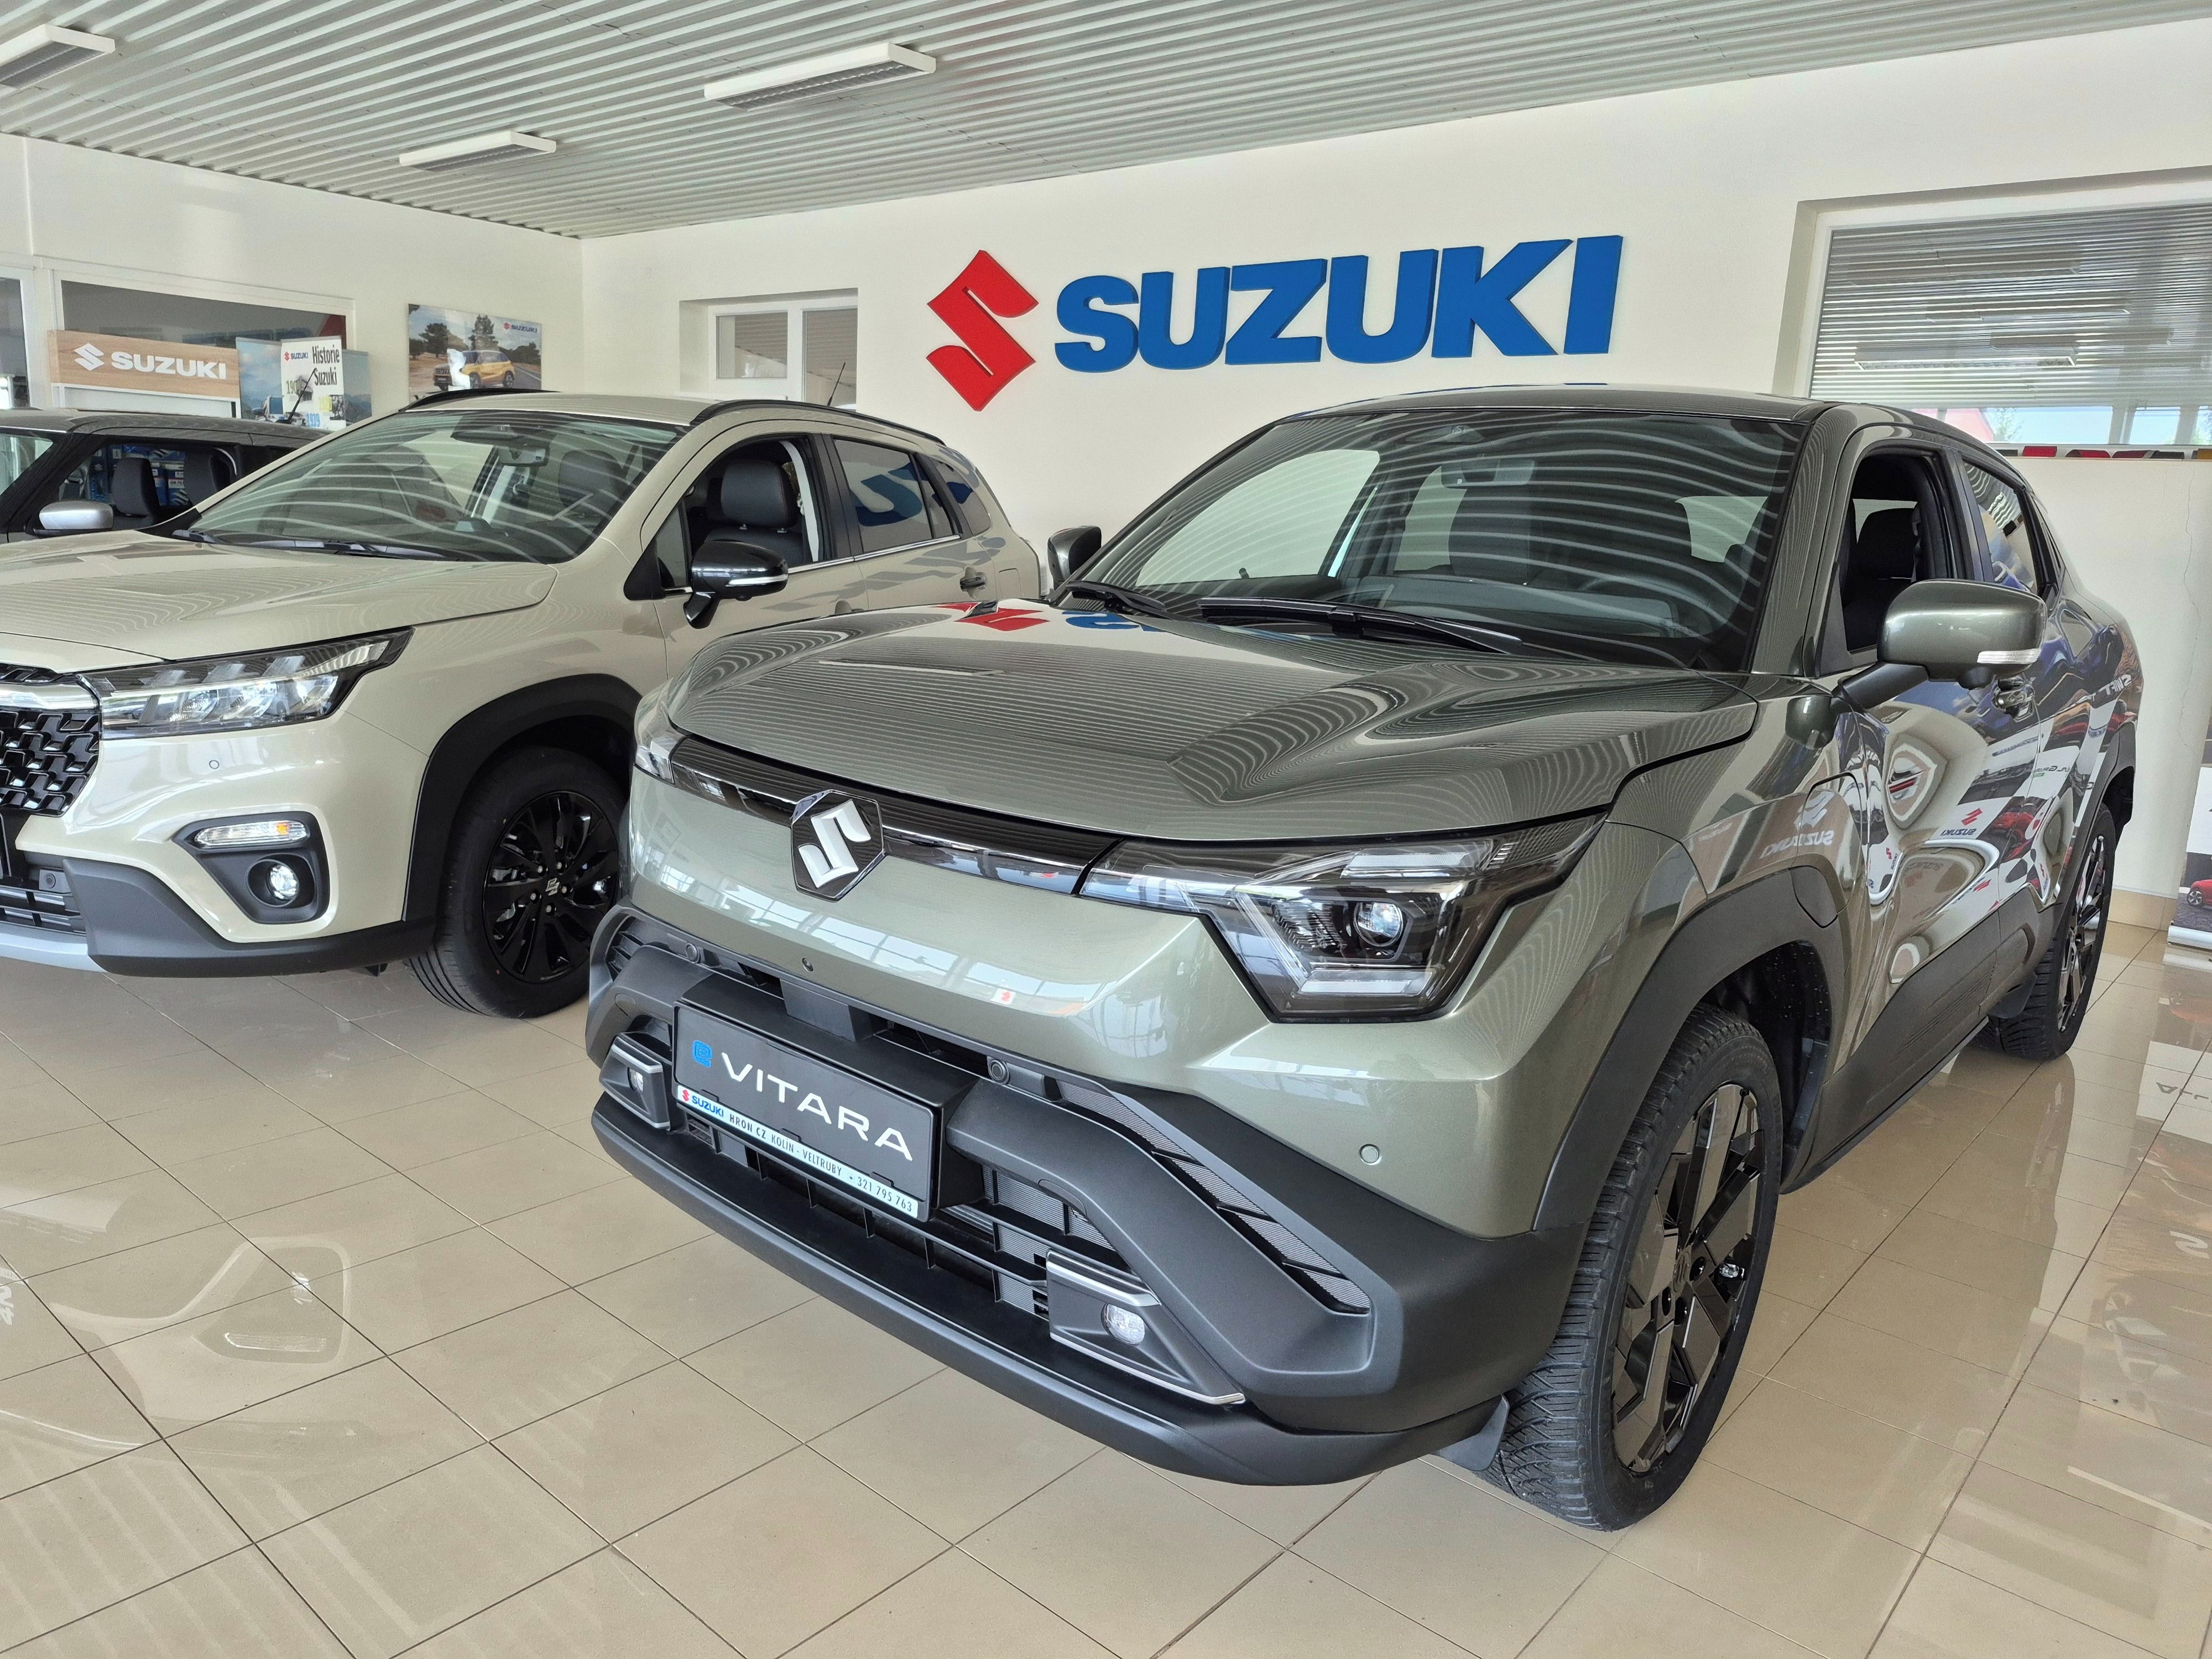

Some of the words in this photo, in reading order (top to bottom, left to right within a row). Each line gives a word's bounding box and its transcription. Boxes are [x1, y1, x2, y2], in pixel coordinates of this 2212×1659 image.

[1055, 234, 1623, 373] SUZUKI
[512, 325, 537, 333] SUZUKI
[111, 351, 226, 379] SUZUKI
[312, 345, 340, 364] Historie
[313, 367, 337, 385] Suzuki
[722, 1052, 912, 1161] VITARA
[692, 1095, 724, 1117] SUZUKI
[729, 1113, 752, 1132] HRON
[756, 1127, 766, 1139] CZ
[803, 1149, 842, 1176] VELTRUBY
[857, 1176, 872, 1191] 321
[877, 1186, 892, 1202] 795
[896, 1196, 912, 1212] 763
